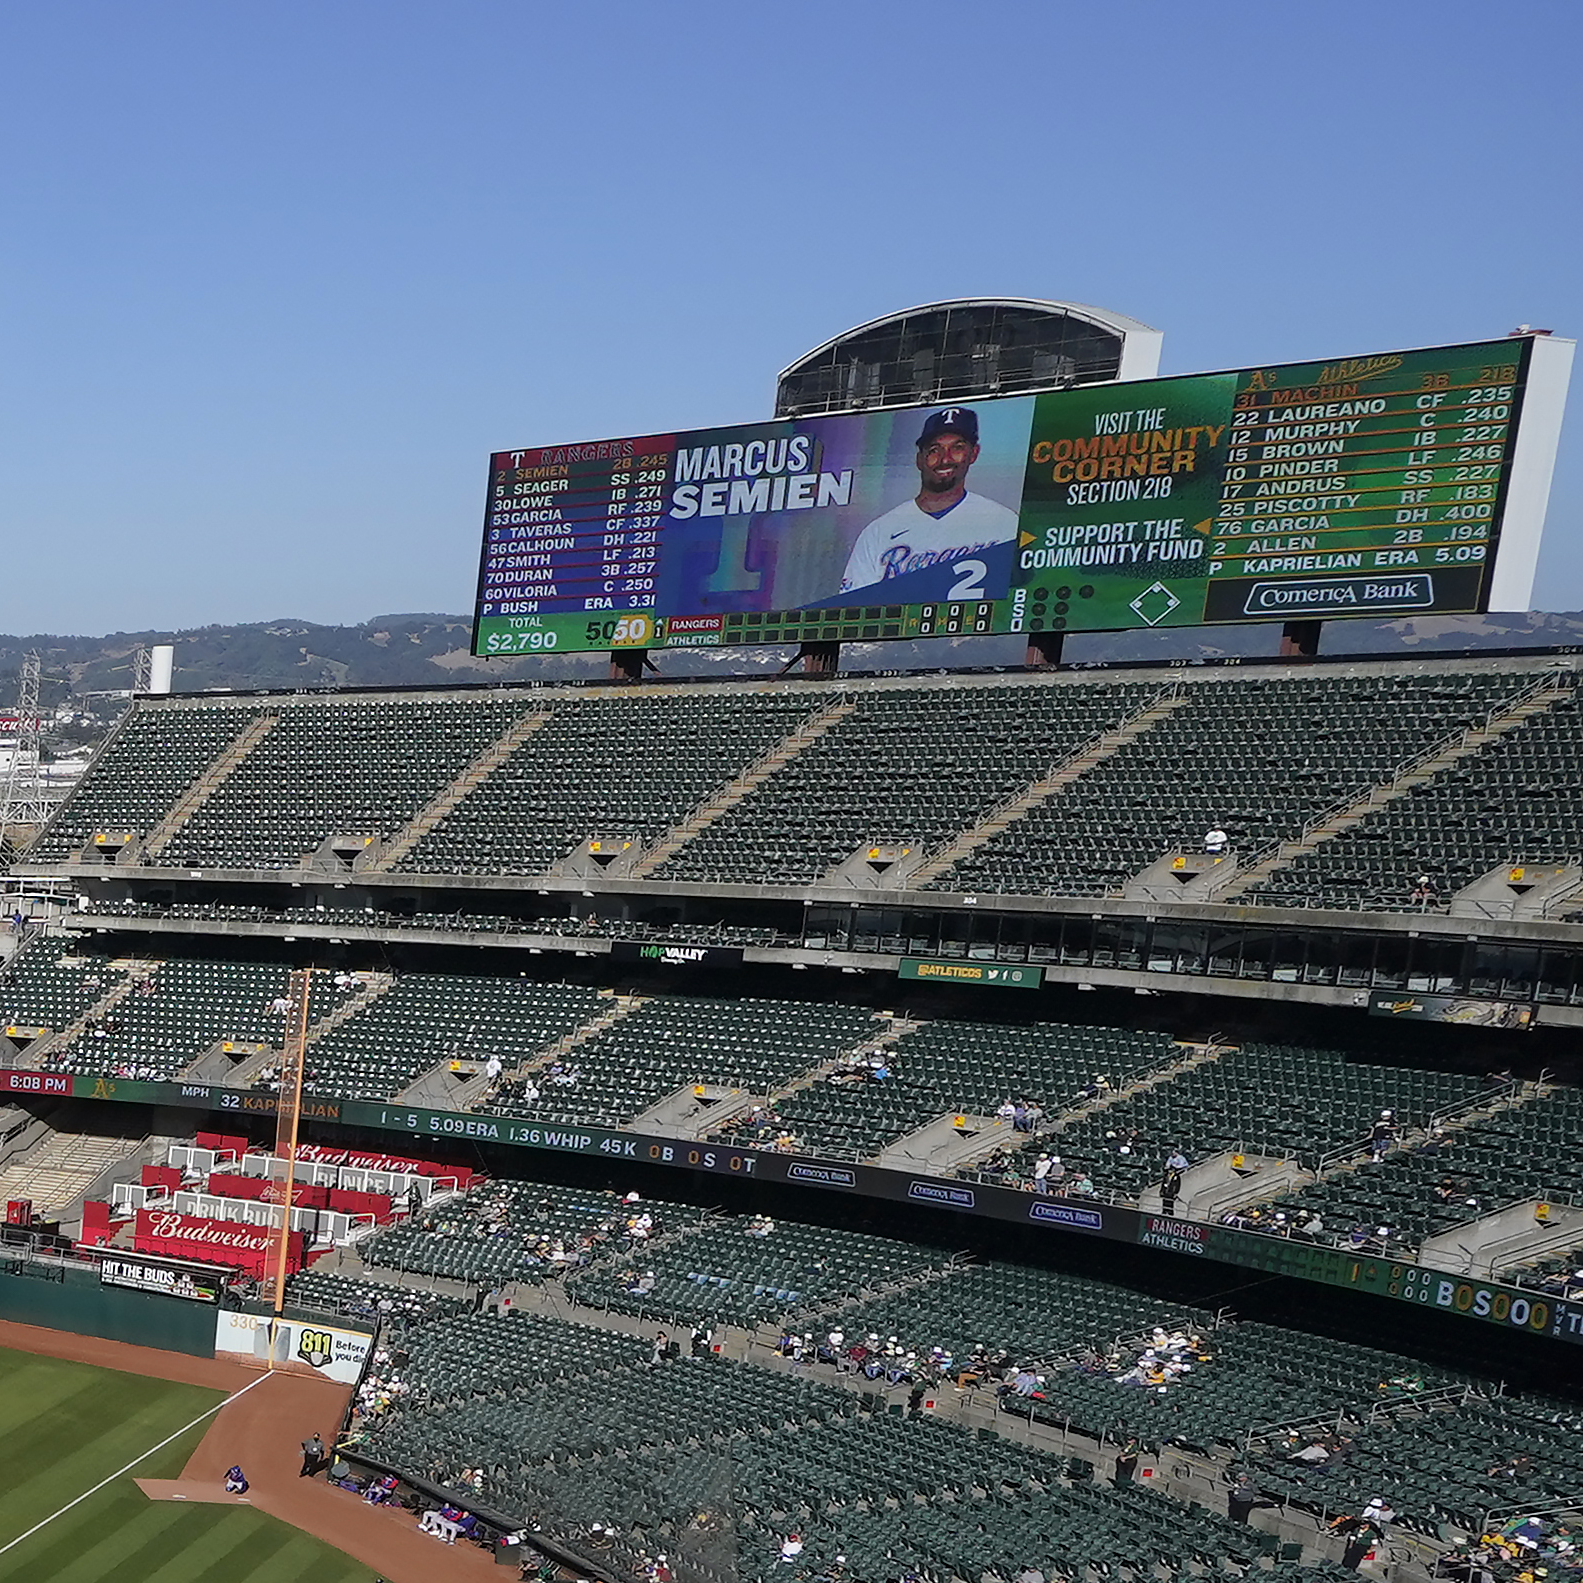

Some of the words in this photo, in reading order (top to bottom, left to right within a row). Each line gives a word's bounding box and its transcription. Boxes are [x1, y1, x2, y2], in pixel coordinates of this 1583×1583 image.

[1315, 354, 1405, 385] Athletics
[1271, 384, 1358, 404] MACHIN
[1267, 399, 1385, 422] LAUREANO
[1095, 411, 1132, 435] VISIT
[1137, 408, 1166, 430] THE
[1265, 420, 1361, 442] MURPHY
[541, 441, 634, 464] RANGERS
[1032, 424, 1225, 463] COMMUNITY
[1262, 440, 1344, 459] BROWN
[674, 435, 810, 482] MARCUS
[1053, 450, 1195, 483] CORNER
[516, 465, 569, 480] SEMIEN
[1259, 459, 1339, 478] PINDER
[514, 480, 568, 495] SEAGER
[669, 470, 853, 519] SEMIEN
[1067, 481, 1142, 505] SECTION
[1143, 476, 1173, 499] 218
[1255, 478, 1346, 496] ANDRUS
[512, 496, 553, 509] LOWE
[1253, 494, 1361, 515] PISCOTTY
[511, 509, 562, 523] GARCIA
[1251, 516, 1330, 533] GARCIA
[511, 523, 572, 538] TAVERAS
[1045, 522, 1138, 546] SUPPORT
[1144, 519, 1184, 538] THE
[1246, 536, 1317, 554] ALLEN
[1444, 525, 1487, 541] .194
[508, 538, 575, 553] CALHOUN
[1021, 542, 1143, 569] COMMUNITY
[1147, 539, 1203, 561] FUND
[507, 554, 551, 567] SMITH
[1243, 552, 1361, 574] KAPRIELIAN
[1374, 550, 1419, 564] ERA
[1435, 546, 1485, 561] 5.09
[505, 569, 553, 583] DURAN
[947, 560, 987, 600] 2
[502, 585, 557, 598] VILORIA
[1363, 581, 1417, 600] Bank
[501, 601, 538, 613] BUSH
[585, 597, 613, 609] ERA
[509, 617, 542, 628] TOTAL
[671, 618, 719, 631] RANGERS
[486, 632, 556, 651] $2,790
[667, 634, 719, 645] ATHLETICS
[666, 947, 705, 962] VALLEY
[917, 964, 983, 979] @ATLETICOS
[10, 1075, 41, 1090] 6:08
[44, 1078, 67, 1092] PM
[91, 1078, 115, 1098] A's
[181, 1086, 209, 1098] MPH
[220, 1094, 240, 1108] 32
[429, 1116, 465, 1133] 5.09
[466, 1121, 499, 1138] ERA
[509, 1128, 540, 1144] 1.36
[543, 1132, 592, 1149] WHIP
[599, 1139, 621, 1154] 45
[624, 1141, 637, 1156] K
[148, 1211, 275, 1251] Budweiser
[1151, 1218, 1202, 1241] RANGERS
[1142, 1233, 1204, 1255] ATHLETICS
[102, 1259, 120, 1277] HIT
[122, 1263, 142, 1280] THE
[144, 1267, 175, 1286] BUDS
[230, 1314, 258, 1330] 330
[301, 1329, 331, 1355] 811
[336, 1340, 366, 1354] Before
[335, 1352, 352, 1362] you
